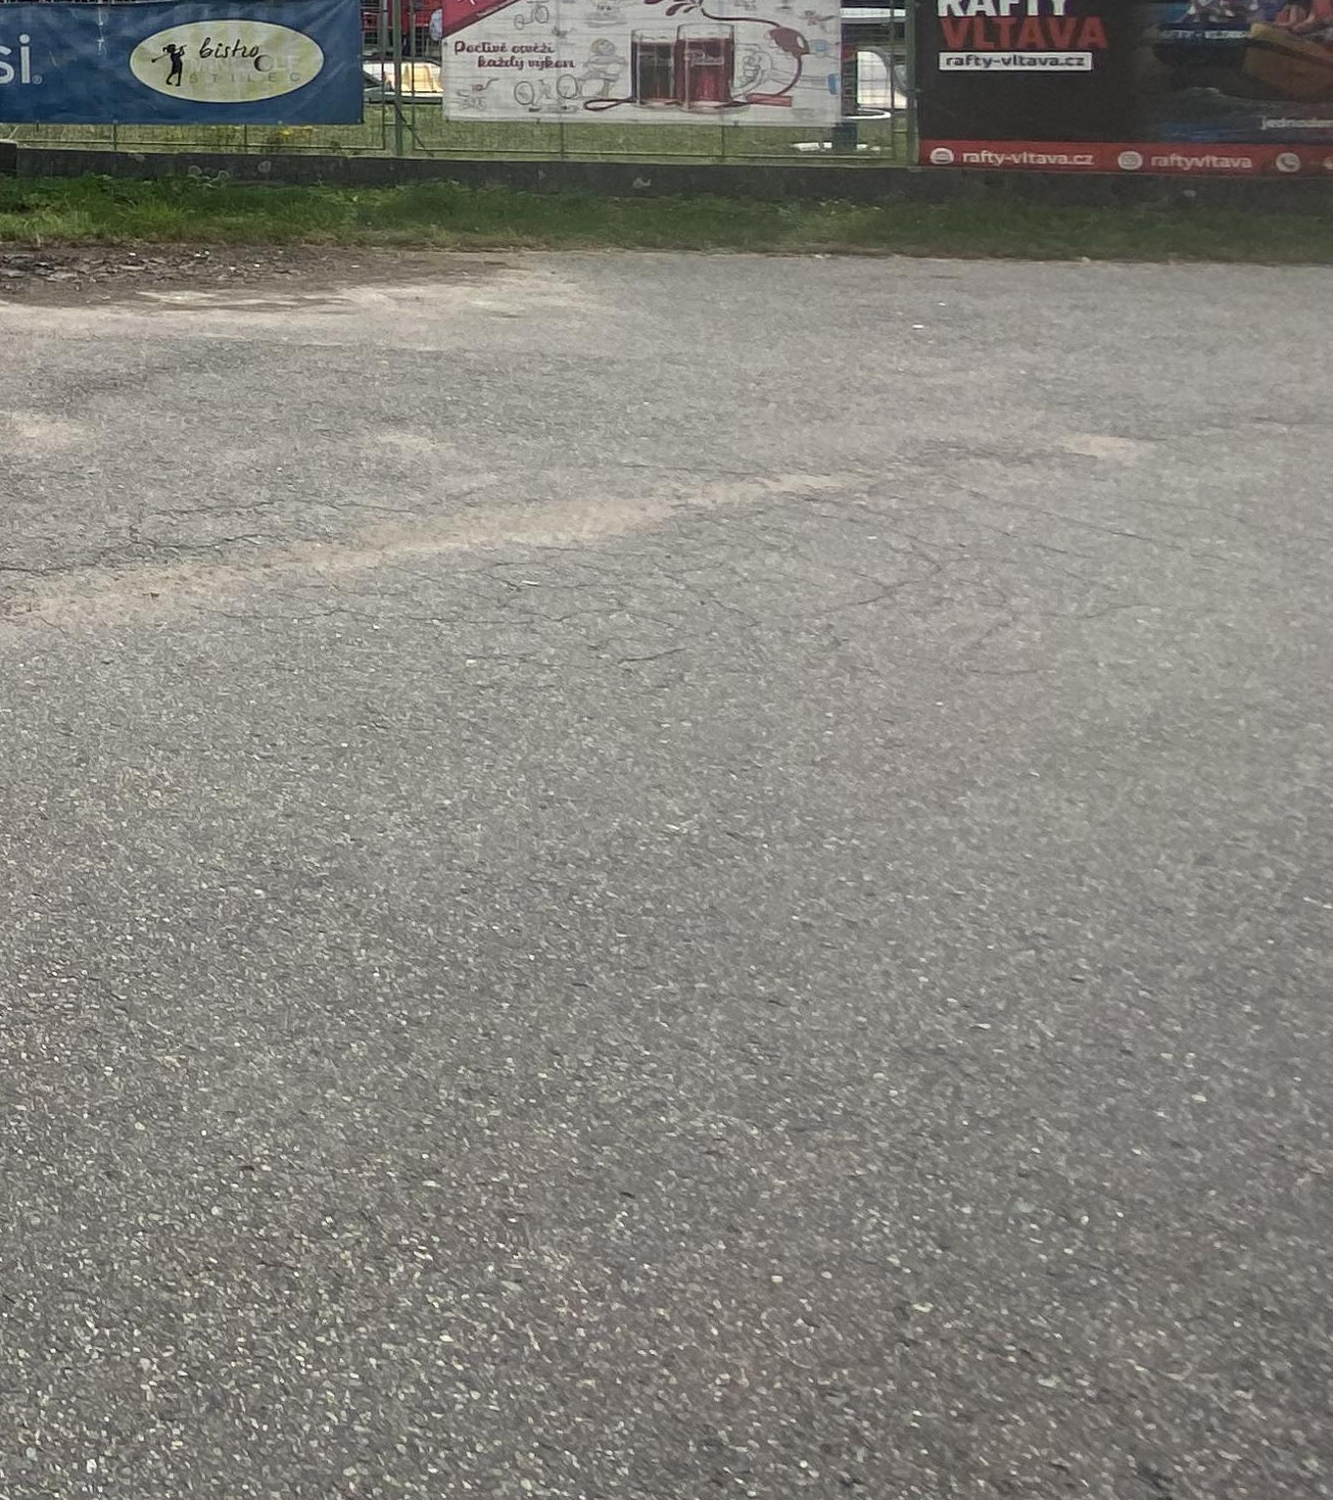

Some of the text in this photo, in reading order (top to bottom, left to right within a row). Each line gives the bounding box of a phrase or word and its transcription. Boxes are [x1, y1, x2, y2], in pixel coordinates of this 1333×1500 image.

[939, 16, 1108, 49] VLTAVA
[199, 37, 259, 59] bistro
[945, 53, 1086, 68] rafty-vltava.cz
[962, 149, 1253, 170] rafty-vltava.cz raftyvltava
